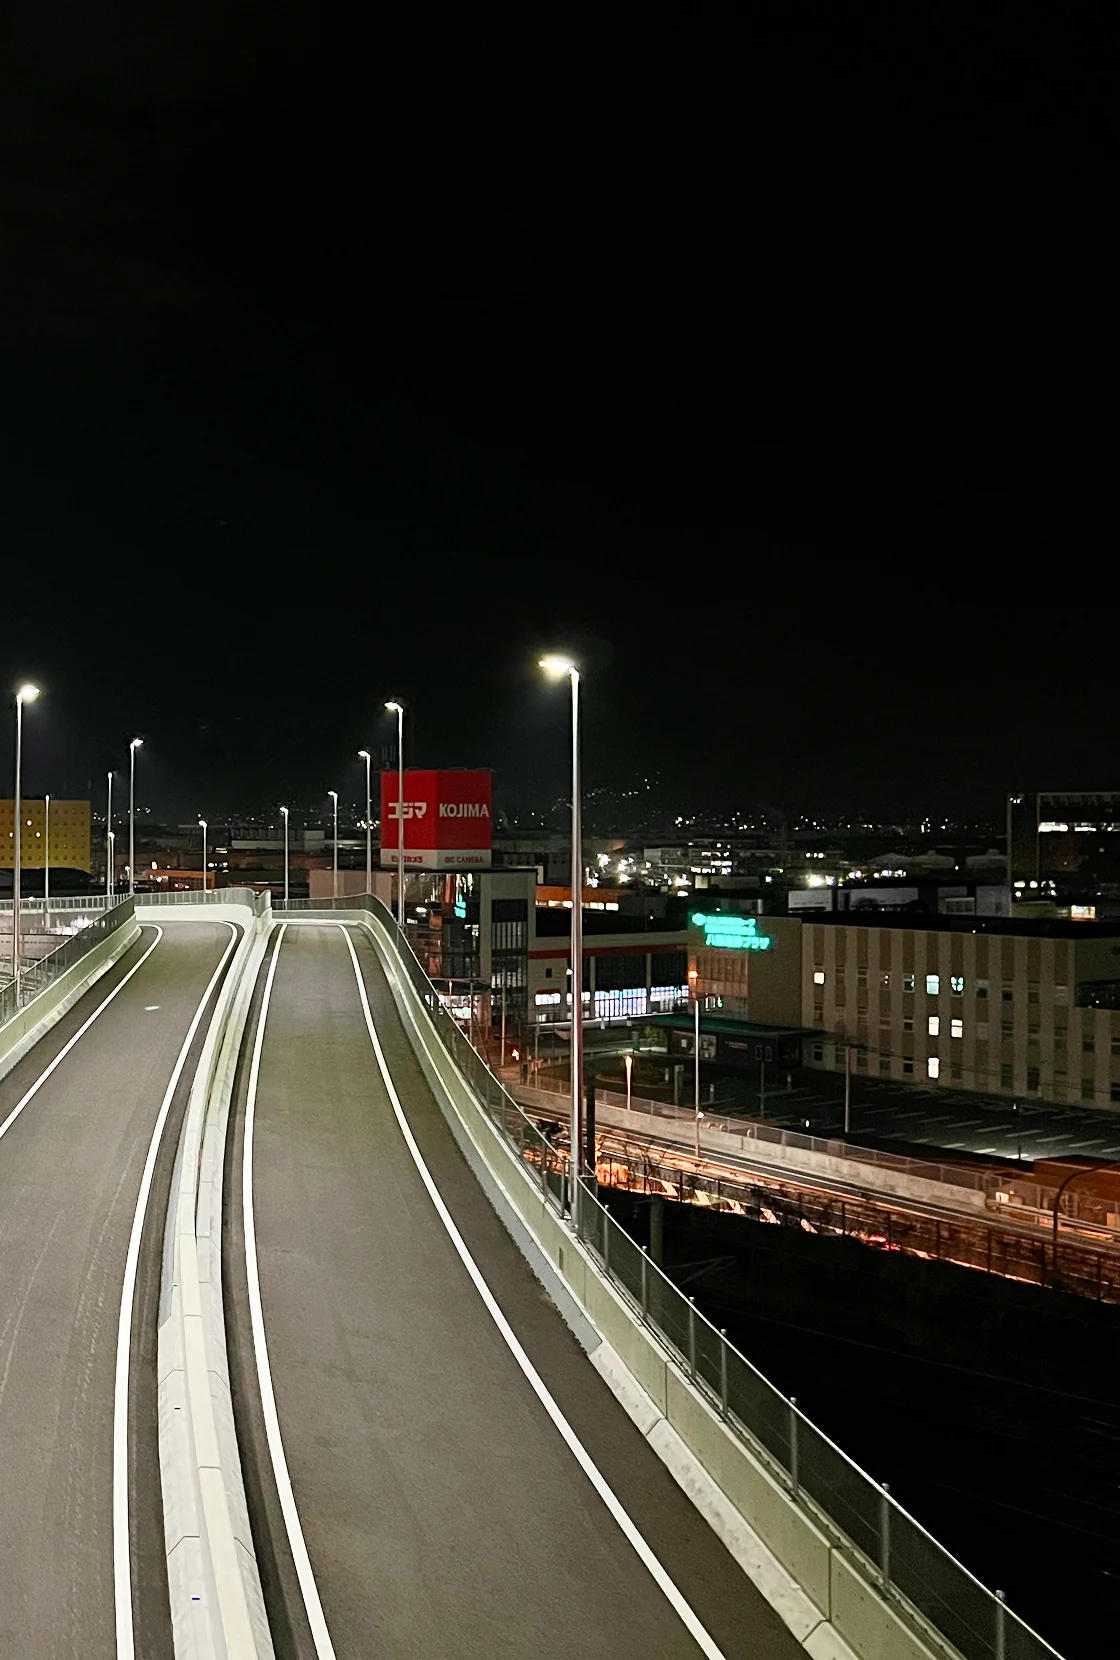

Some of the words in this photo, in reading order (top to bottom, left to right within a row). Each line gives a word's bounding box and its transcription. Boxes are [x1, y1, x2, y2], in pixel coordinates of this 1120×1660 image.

[388, 802, 427, 819] コジマ
[439, 803, 490, 818] KOJIMA
